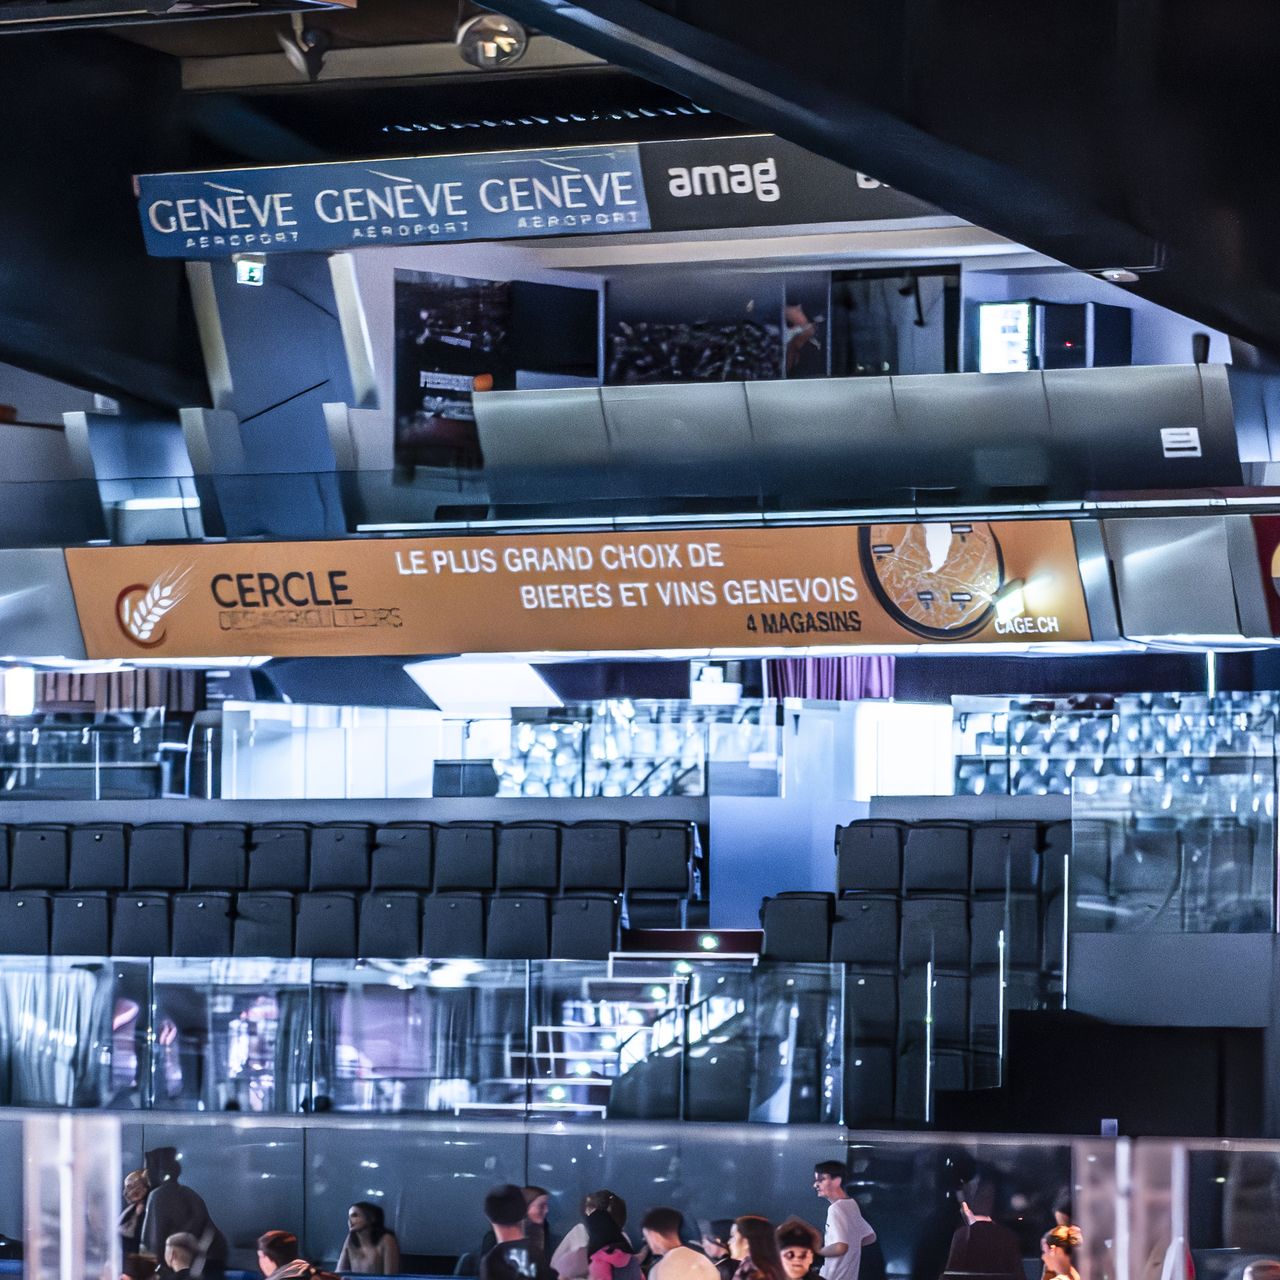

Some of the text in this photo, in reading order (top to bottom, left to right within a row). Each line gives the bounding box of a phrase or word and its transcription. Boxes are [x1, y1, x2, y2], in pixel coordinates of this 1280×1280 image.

[149, 159, 637, 233] GENÈVE GENÈVE GENÈVE
[668, 157, 781, 202] amag
[395, 542, 725, 576] LE PLUS GRAND CHOIX DE
[211, 570, 354, 609] CERCLE
[520, 576, 859, 610] BIERES ET VINS GENEVOIS
[747, 610, 863, 635] 4 MAGASINS
